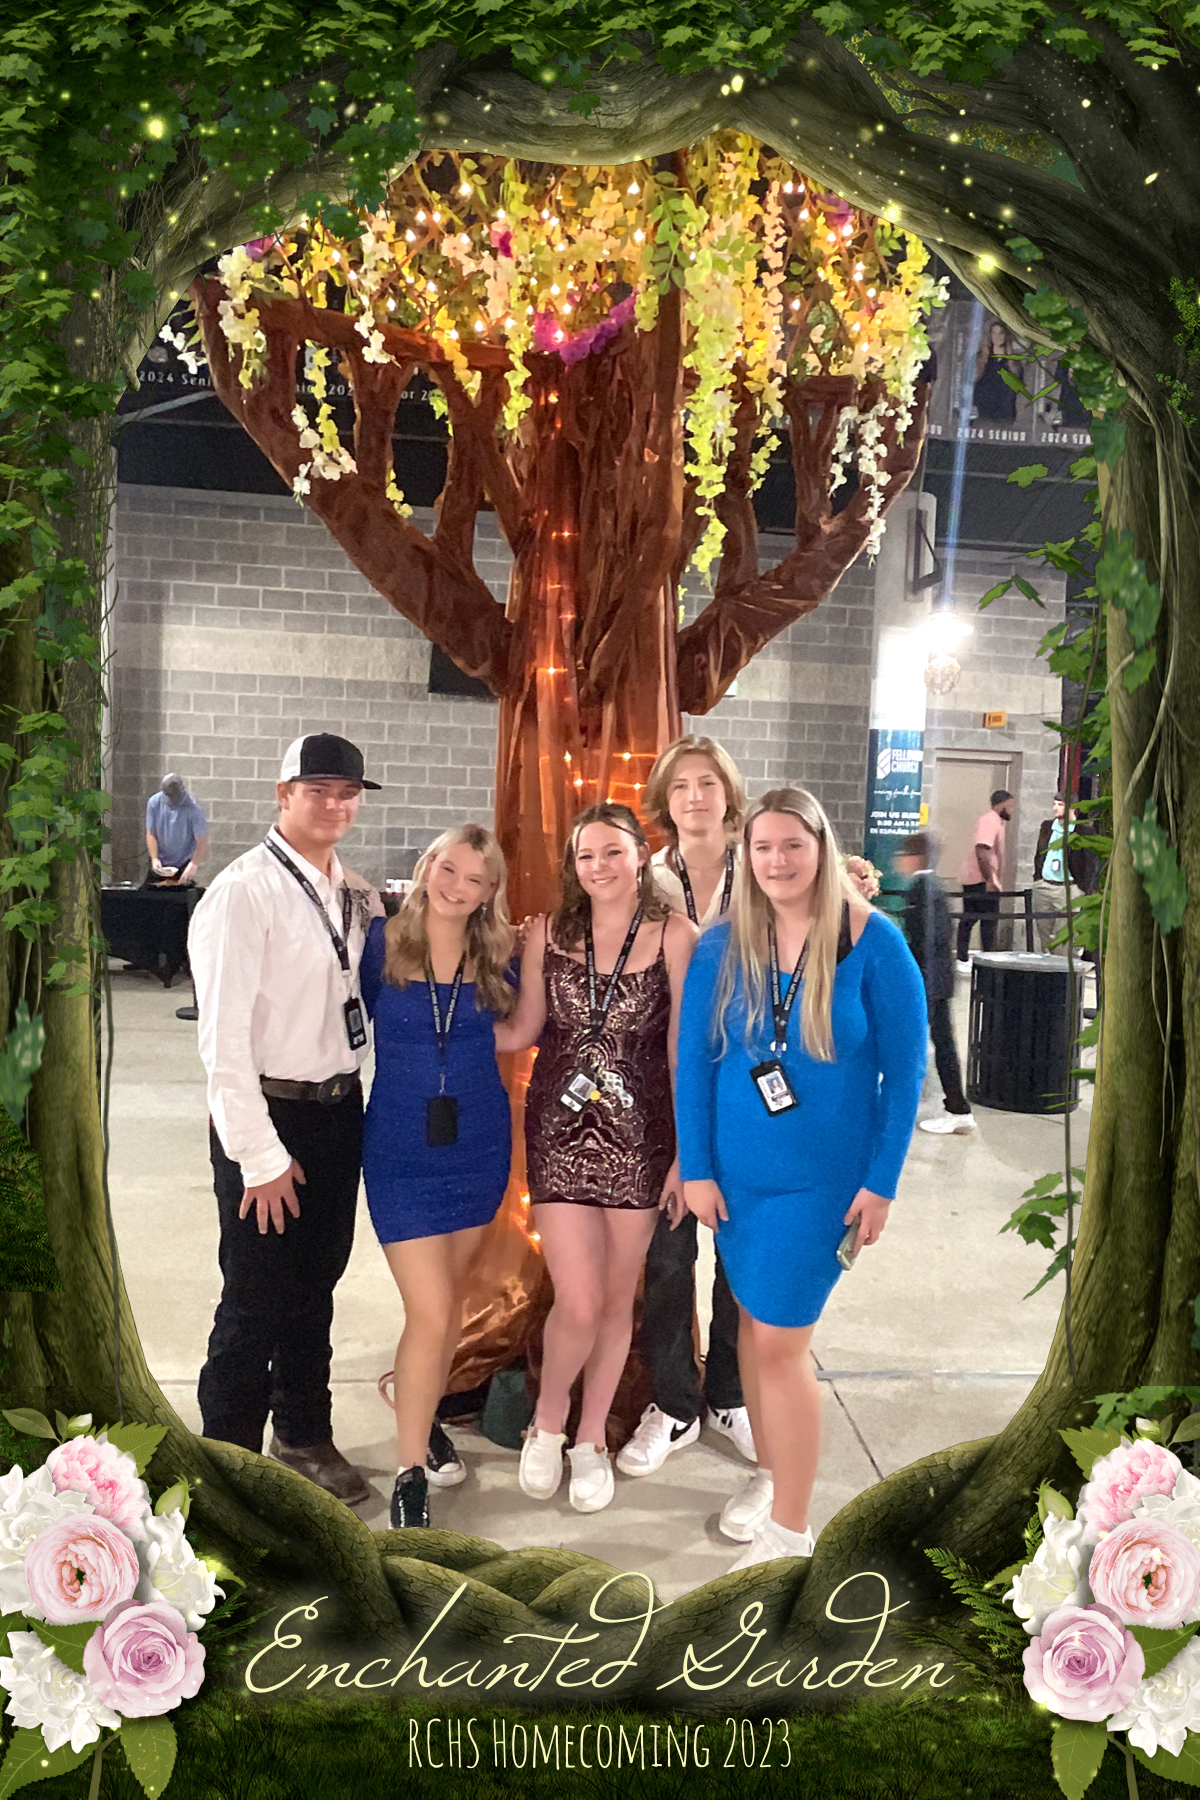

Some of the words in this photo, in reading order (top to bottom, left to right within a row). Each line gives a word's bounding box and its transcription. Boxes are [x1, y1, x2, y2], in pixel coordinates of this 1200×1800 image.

[138, 370, 174, 384] 2024
[181, 372, 213, 387] Seni
[1072, 433, 1093, 445] SEN
[889, 811, 900, 819] US
